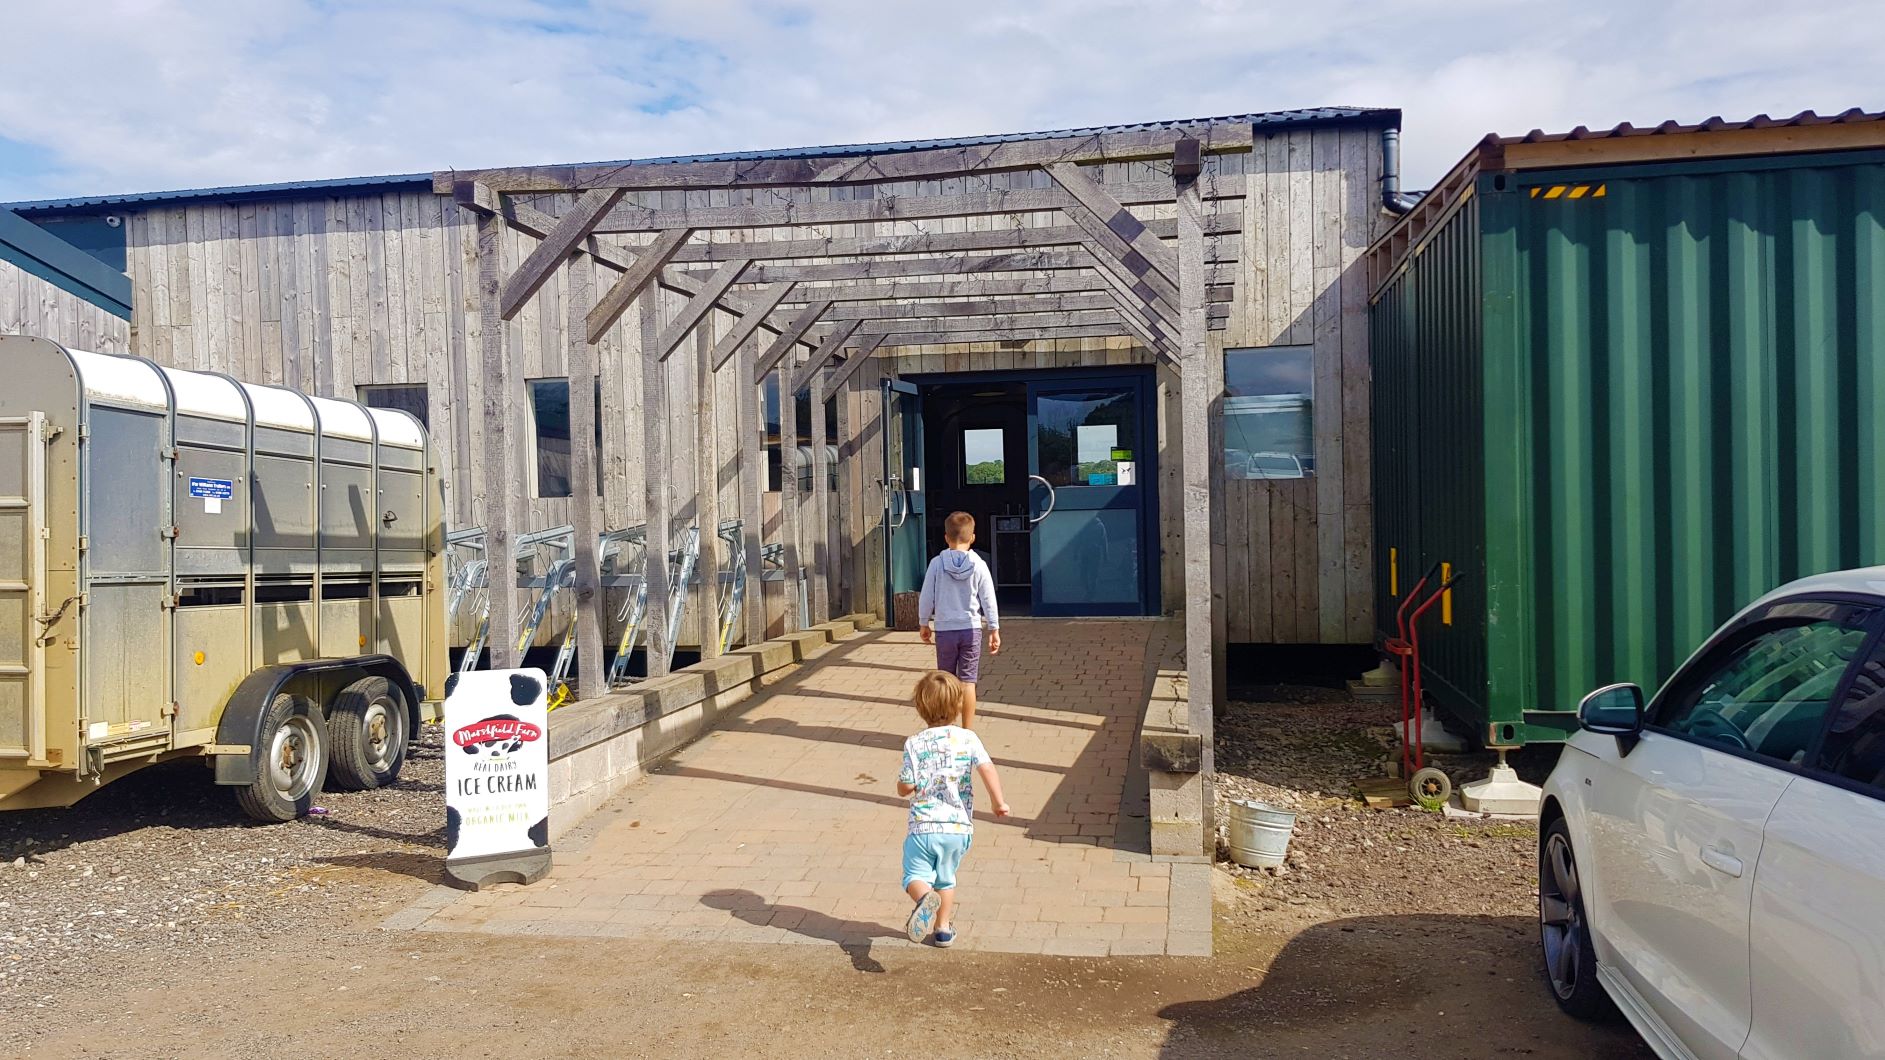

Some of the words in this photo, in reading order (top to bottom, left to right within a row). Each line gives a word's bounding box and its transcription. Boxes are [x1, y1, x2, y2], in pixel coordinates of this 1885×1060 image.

[458, 723, 514, 745] Marshfield
[515, 723, 538, 737] Farm
[473, 761, 491, 772] REAL
[494, 760, 517, 772] DAIRY
[458, 777, 481, 796] ICE
[487, 773, 537, 794] CREAM
[465, 813, 503, 826] ORGANIC
